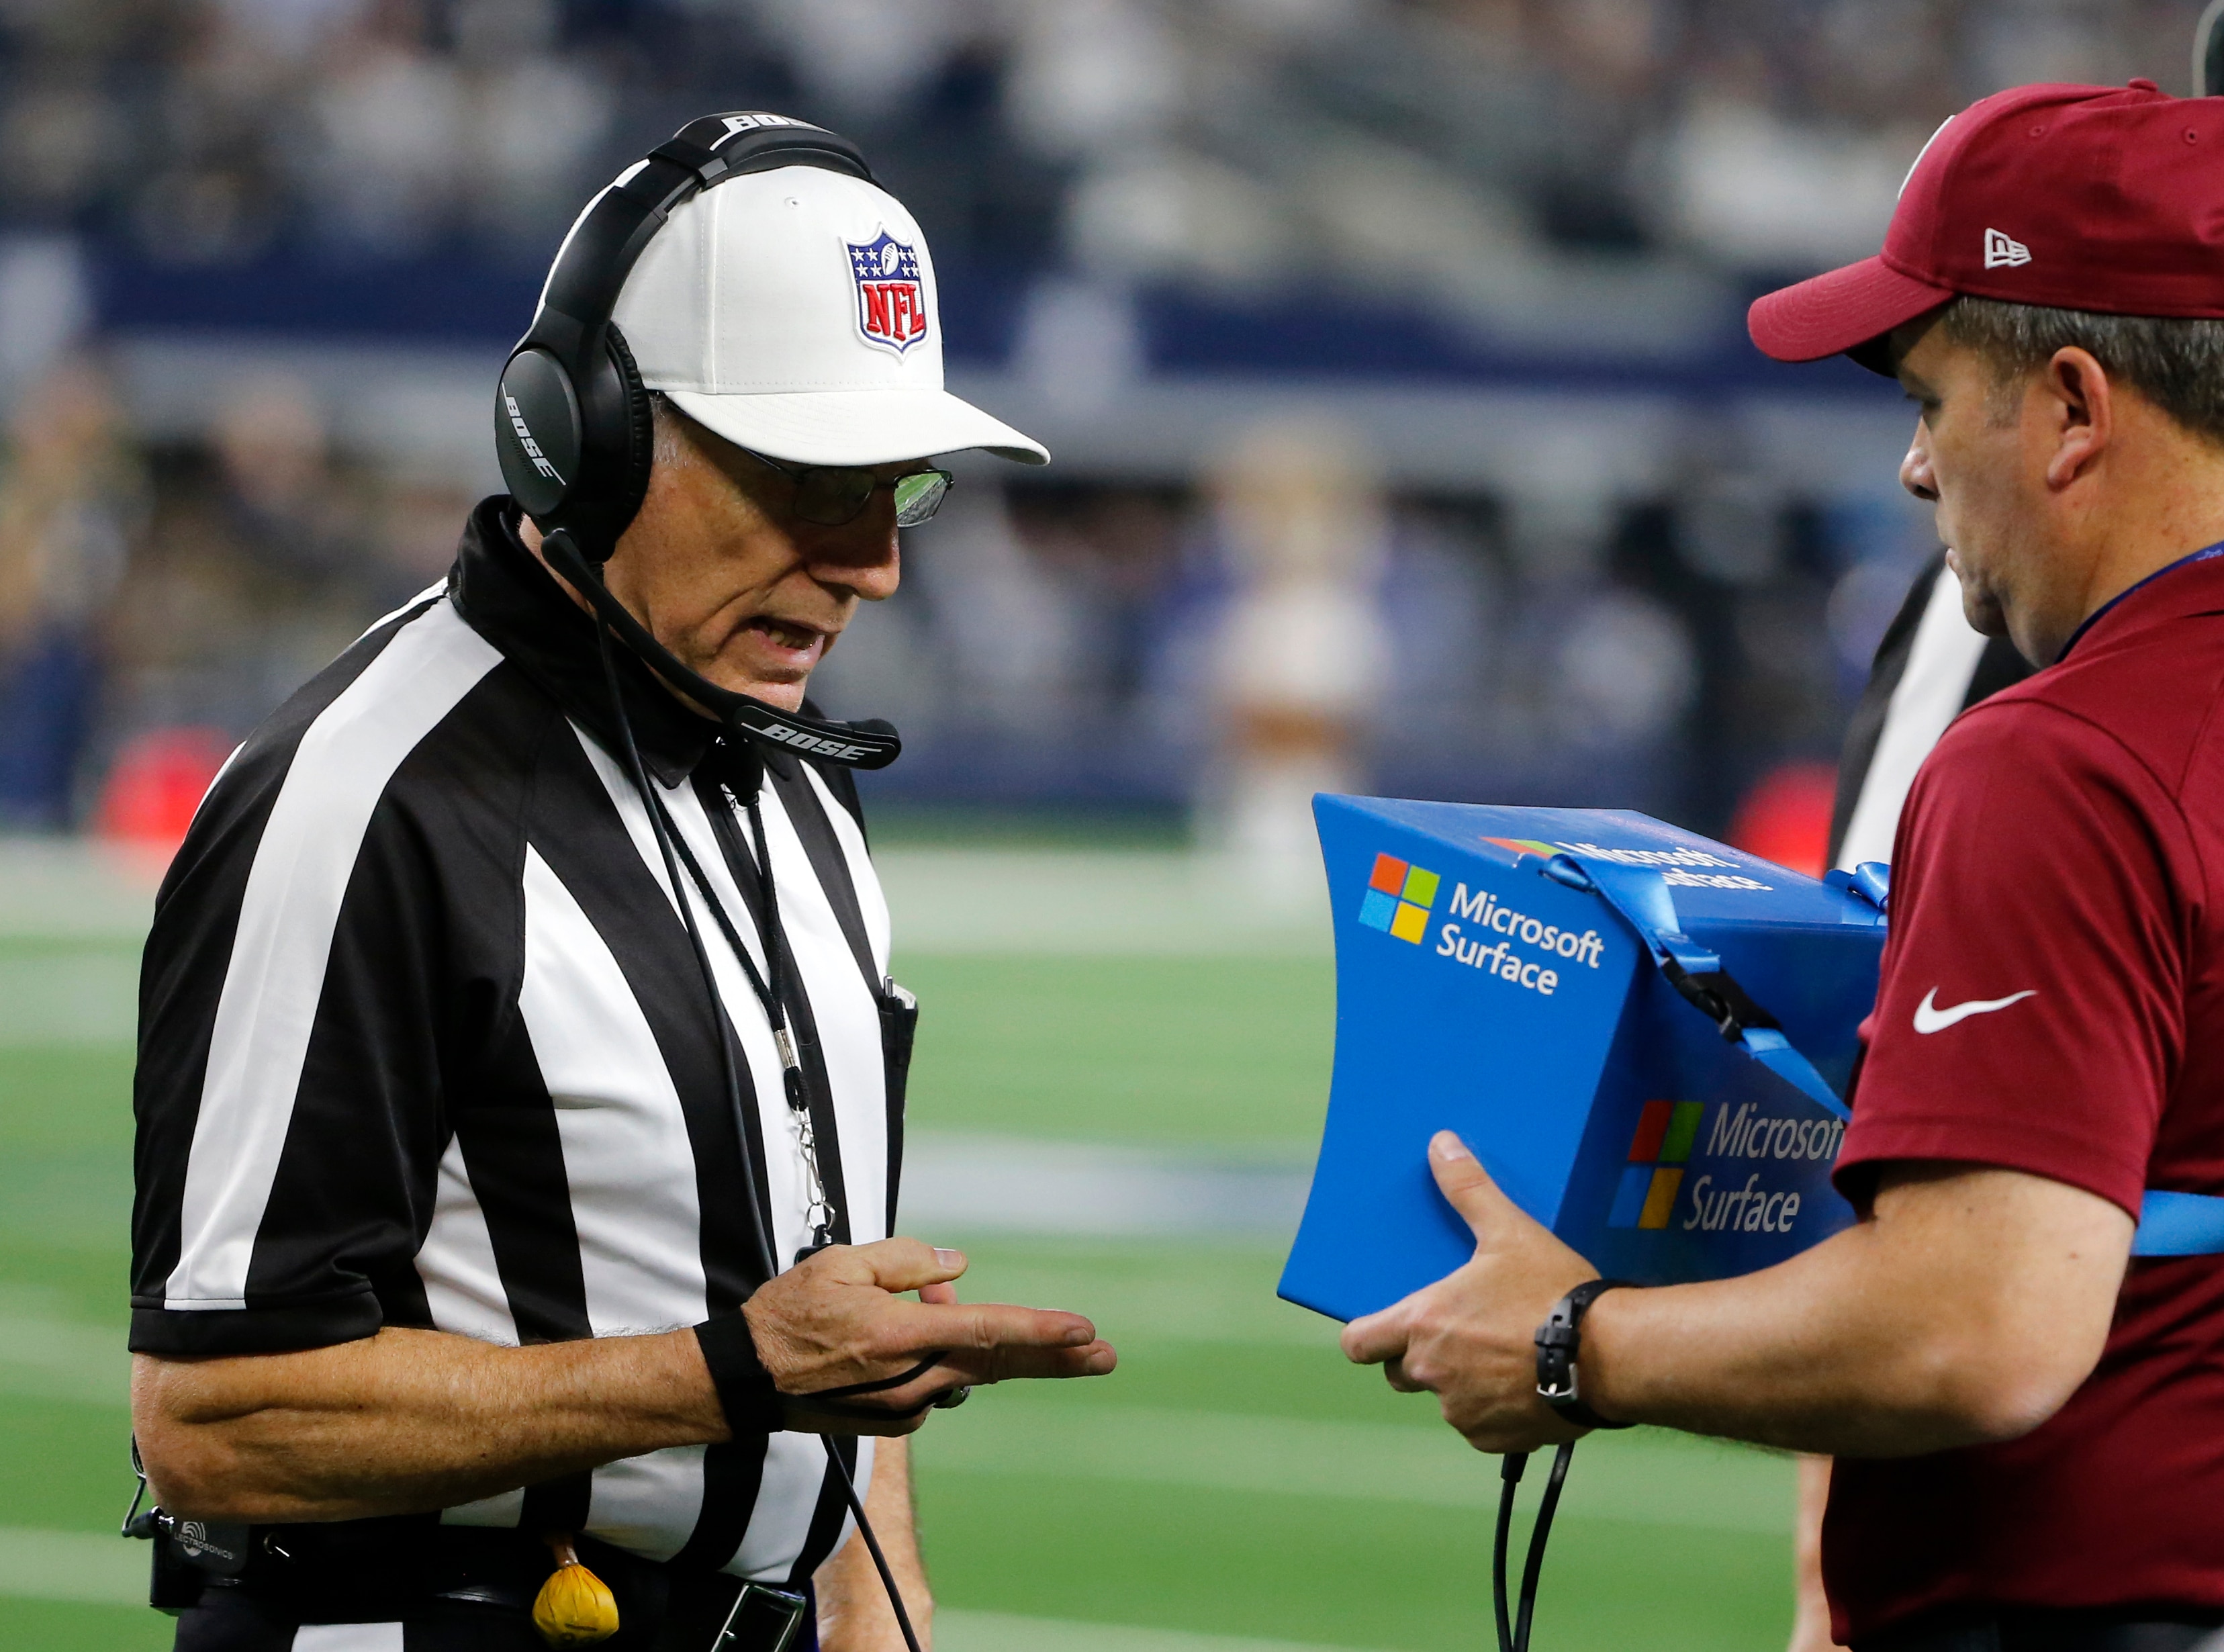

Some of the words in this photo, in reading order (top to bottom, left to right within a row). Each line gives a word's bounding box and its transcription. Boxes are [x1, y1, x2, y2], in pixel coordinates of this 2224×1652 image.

[863, 283, 925, 341] NFL
[502, 382, 567, 486] BOSE
[741, 723, 882, 761] BOSE
[1661, 867, 1774, 892] urface
[1449, 882, 1604, 969] Microsoft
[1436, 923, 1559, 995] Surface
[1683, 1173, 1801, 1232] Surface
